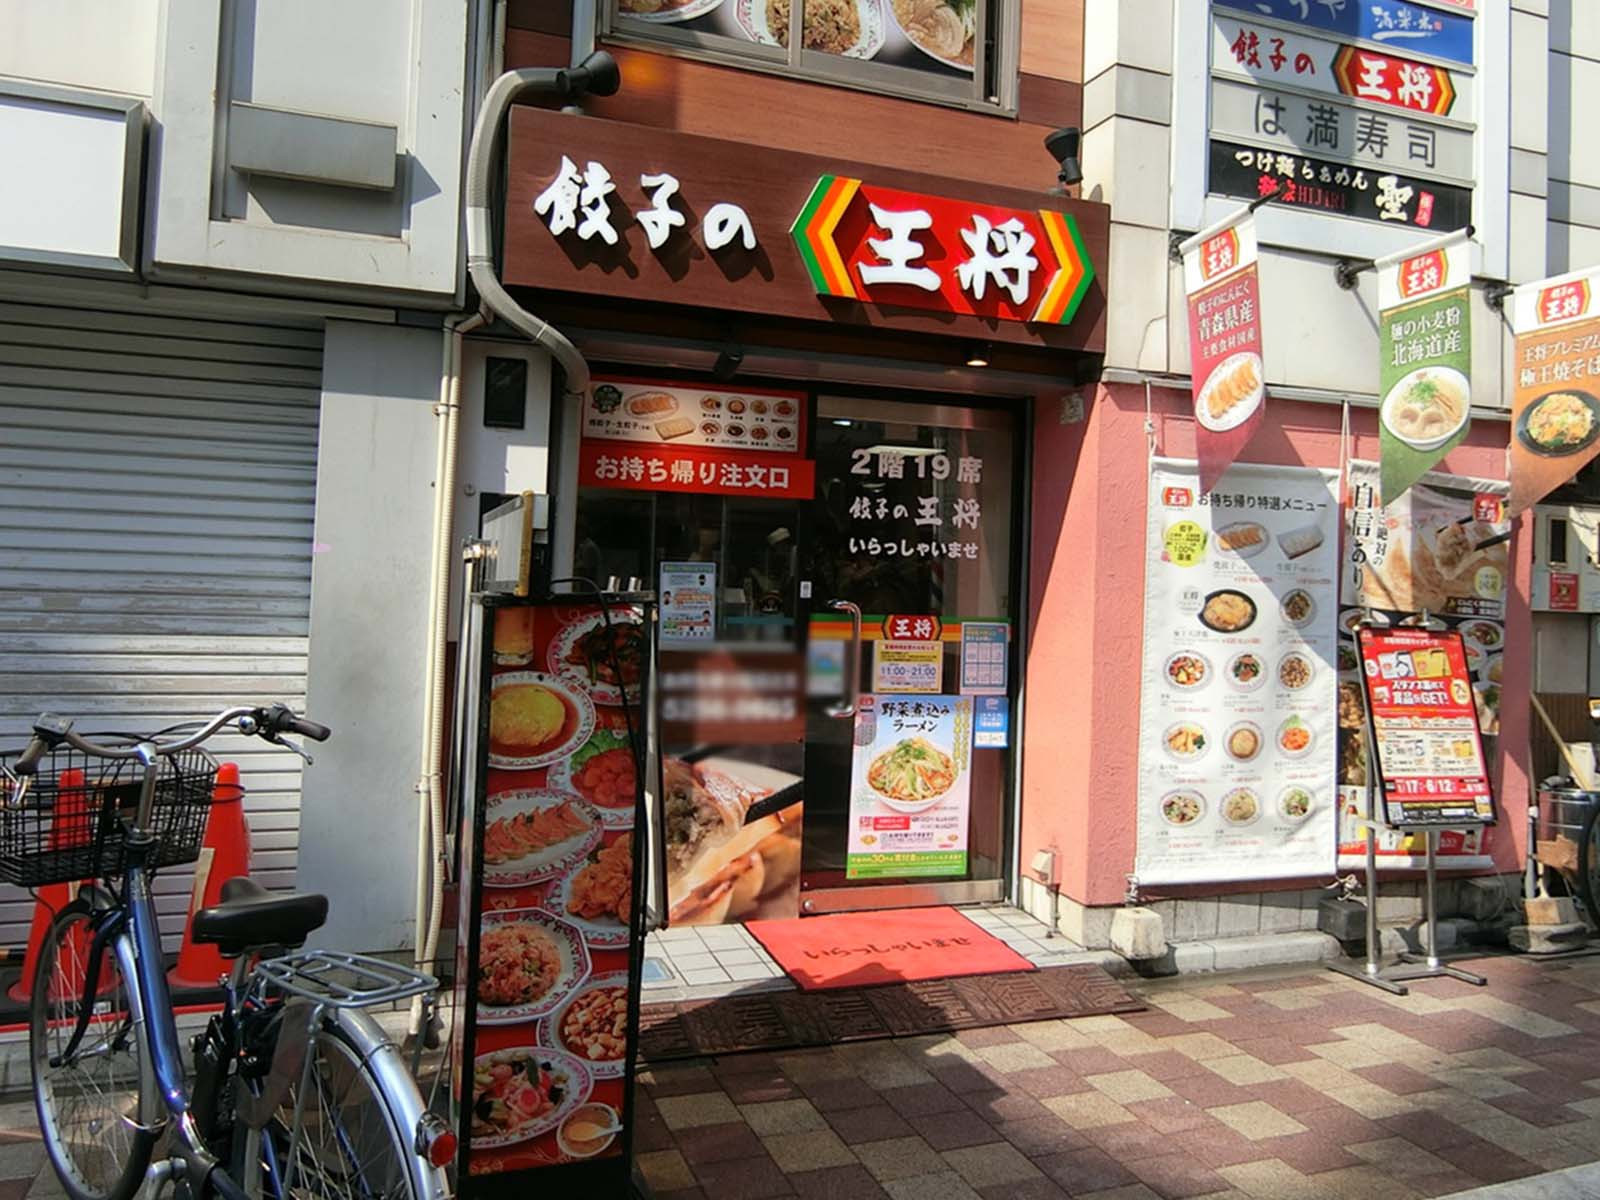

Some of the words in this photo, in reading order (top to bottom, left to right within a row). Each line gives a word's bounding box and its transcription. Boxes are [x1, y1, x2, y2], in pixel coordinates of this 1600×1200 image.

[1231, 28, 1316, 76] 餃子の
[1356, 55, 1433, 109] 王将
[1255, 94, 1436, 169] は満寿司
[1375, 174, 1414, 221] 聖
[534, 155, 757, 250] 餃子の
[856, 202, 1039, 306] 王将
[1208, 245, 1233, 278] 王将
[1407, 266, 1440, 295] 王将
[1199, 299, 1254, 341] 青森県産
[1545, 295, 1580, 320] 王将
[1392, 330, 1461, 366] 北海道産
[595, 455, 790, 489] お持ち帰り注文口
[1198, 492, 1328, 512] お持ち帰り特選メニュー
[850, 537, 979, 560] いらっしゃいませ
[893, 619, 932, 638] 王将
[880, 701, 951, 719] 野菜煮込み
[893, 719, 938, 733] ラーメン
[803, 936, 973, 960] いらっしゃいませ
